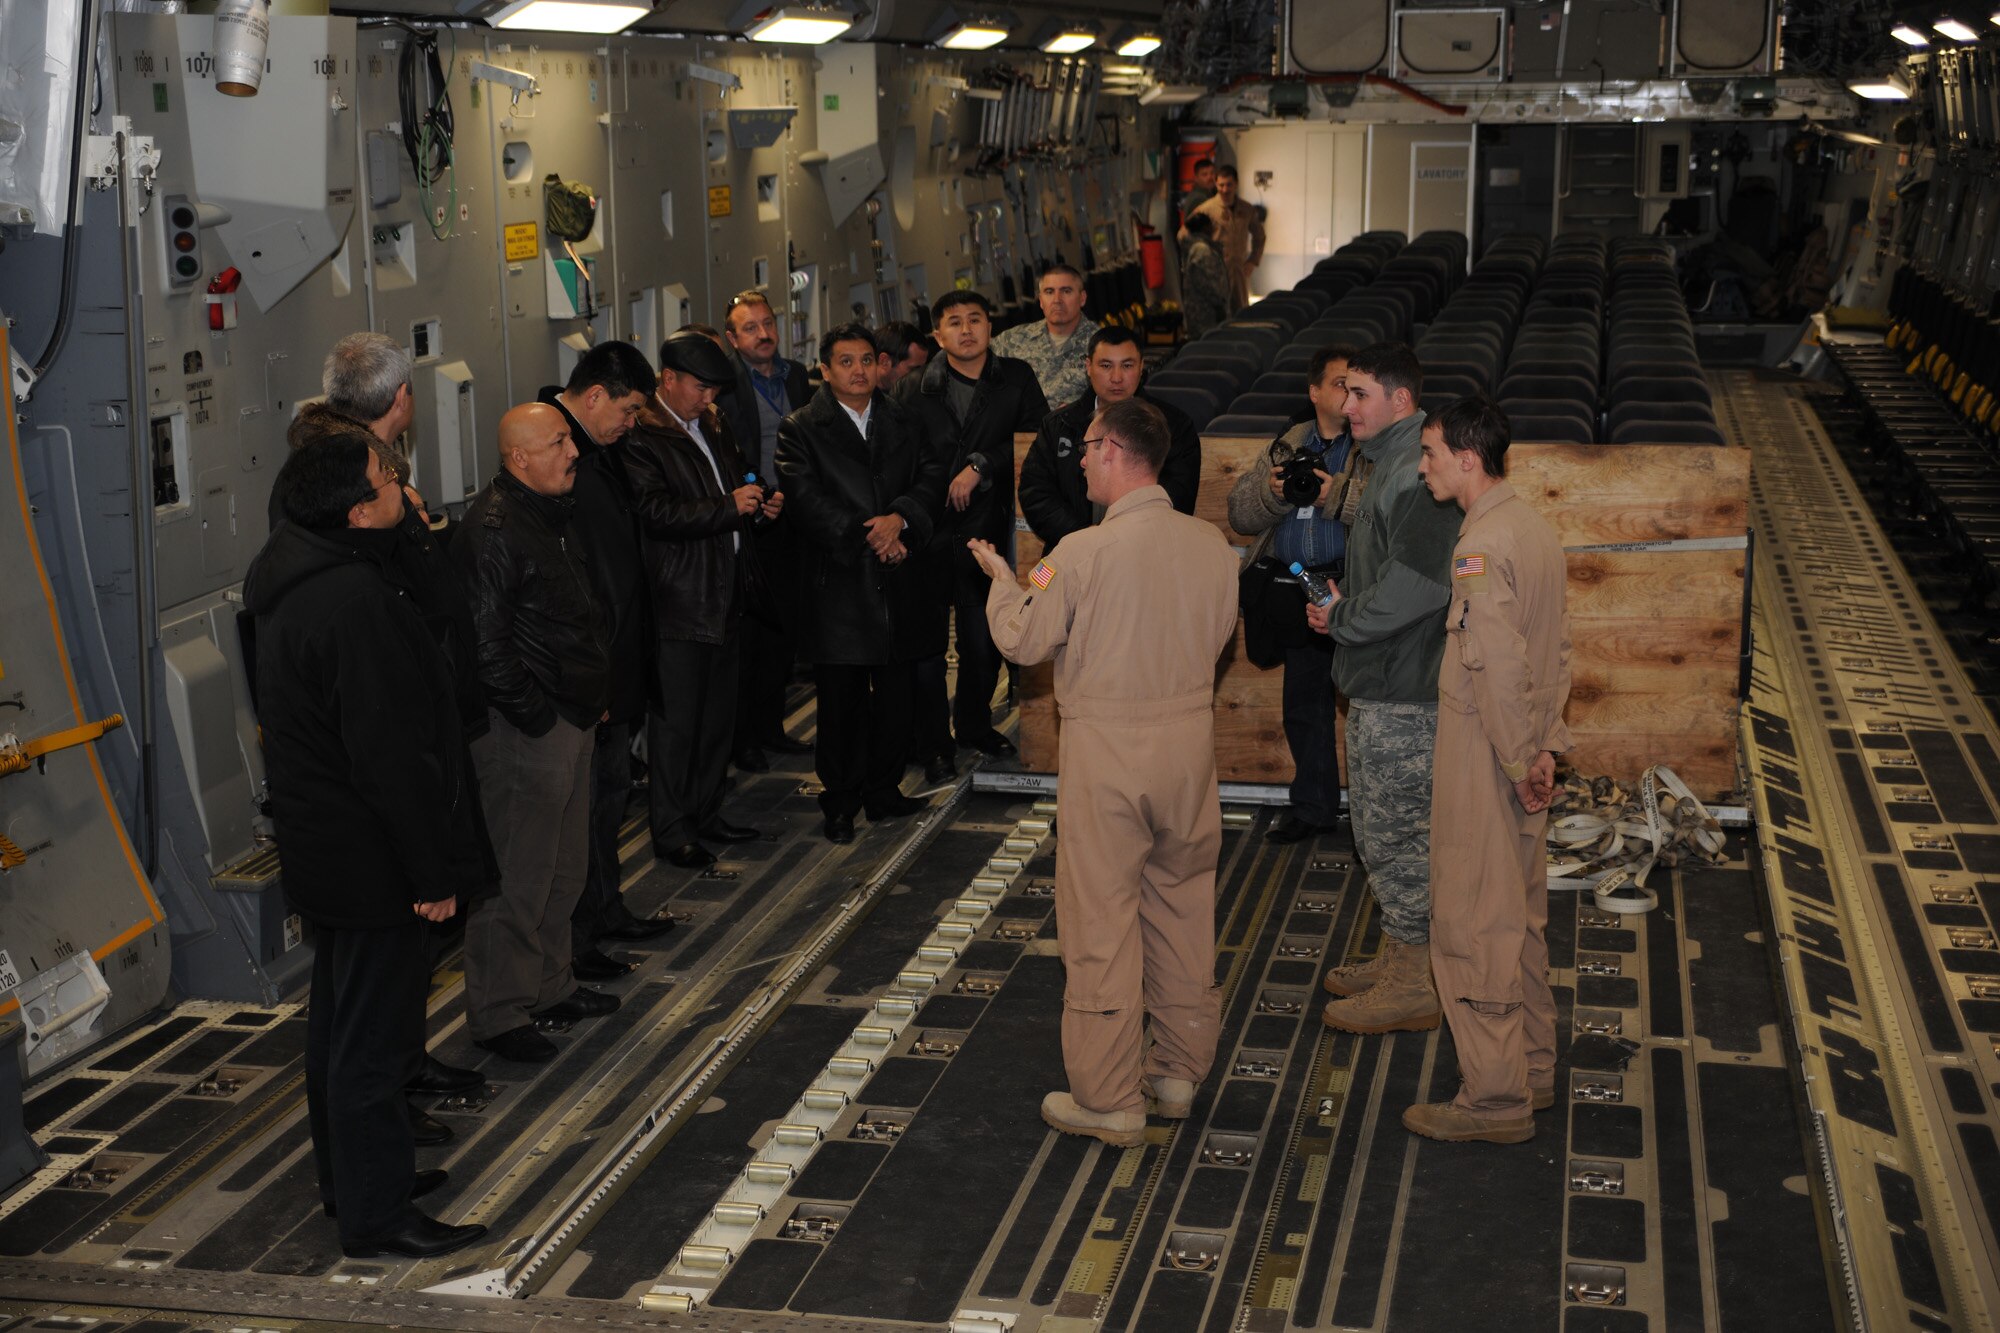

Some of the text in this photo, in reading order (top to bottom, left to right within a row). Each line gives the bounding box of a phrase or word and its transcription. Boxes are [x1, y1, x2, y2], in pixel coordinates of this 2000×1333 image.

[135, 56, 153, 72] 1080
[186, 57, 215, 73] 107
[1417, 169, 1466, 179] LAVATORY
[54, 942, 73, 959] 1110
[123, 952, 138, 968] 1100
